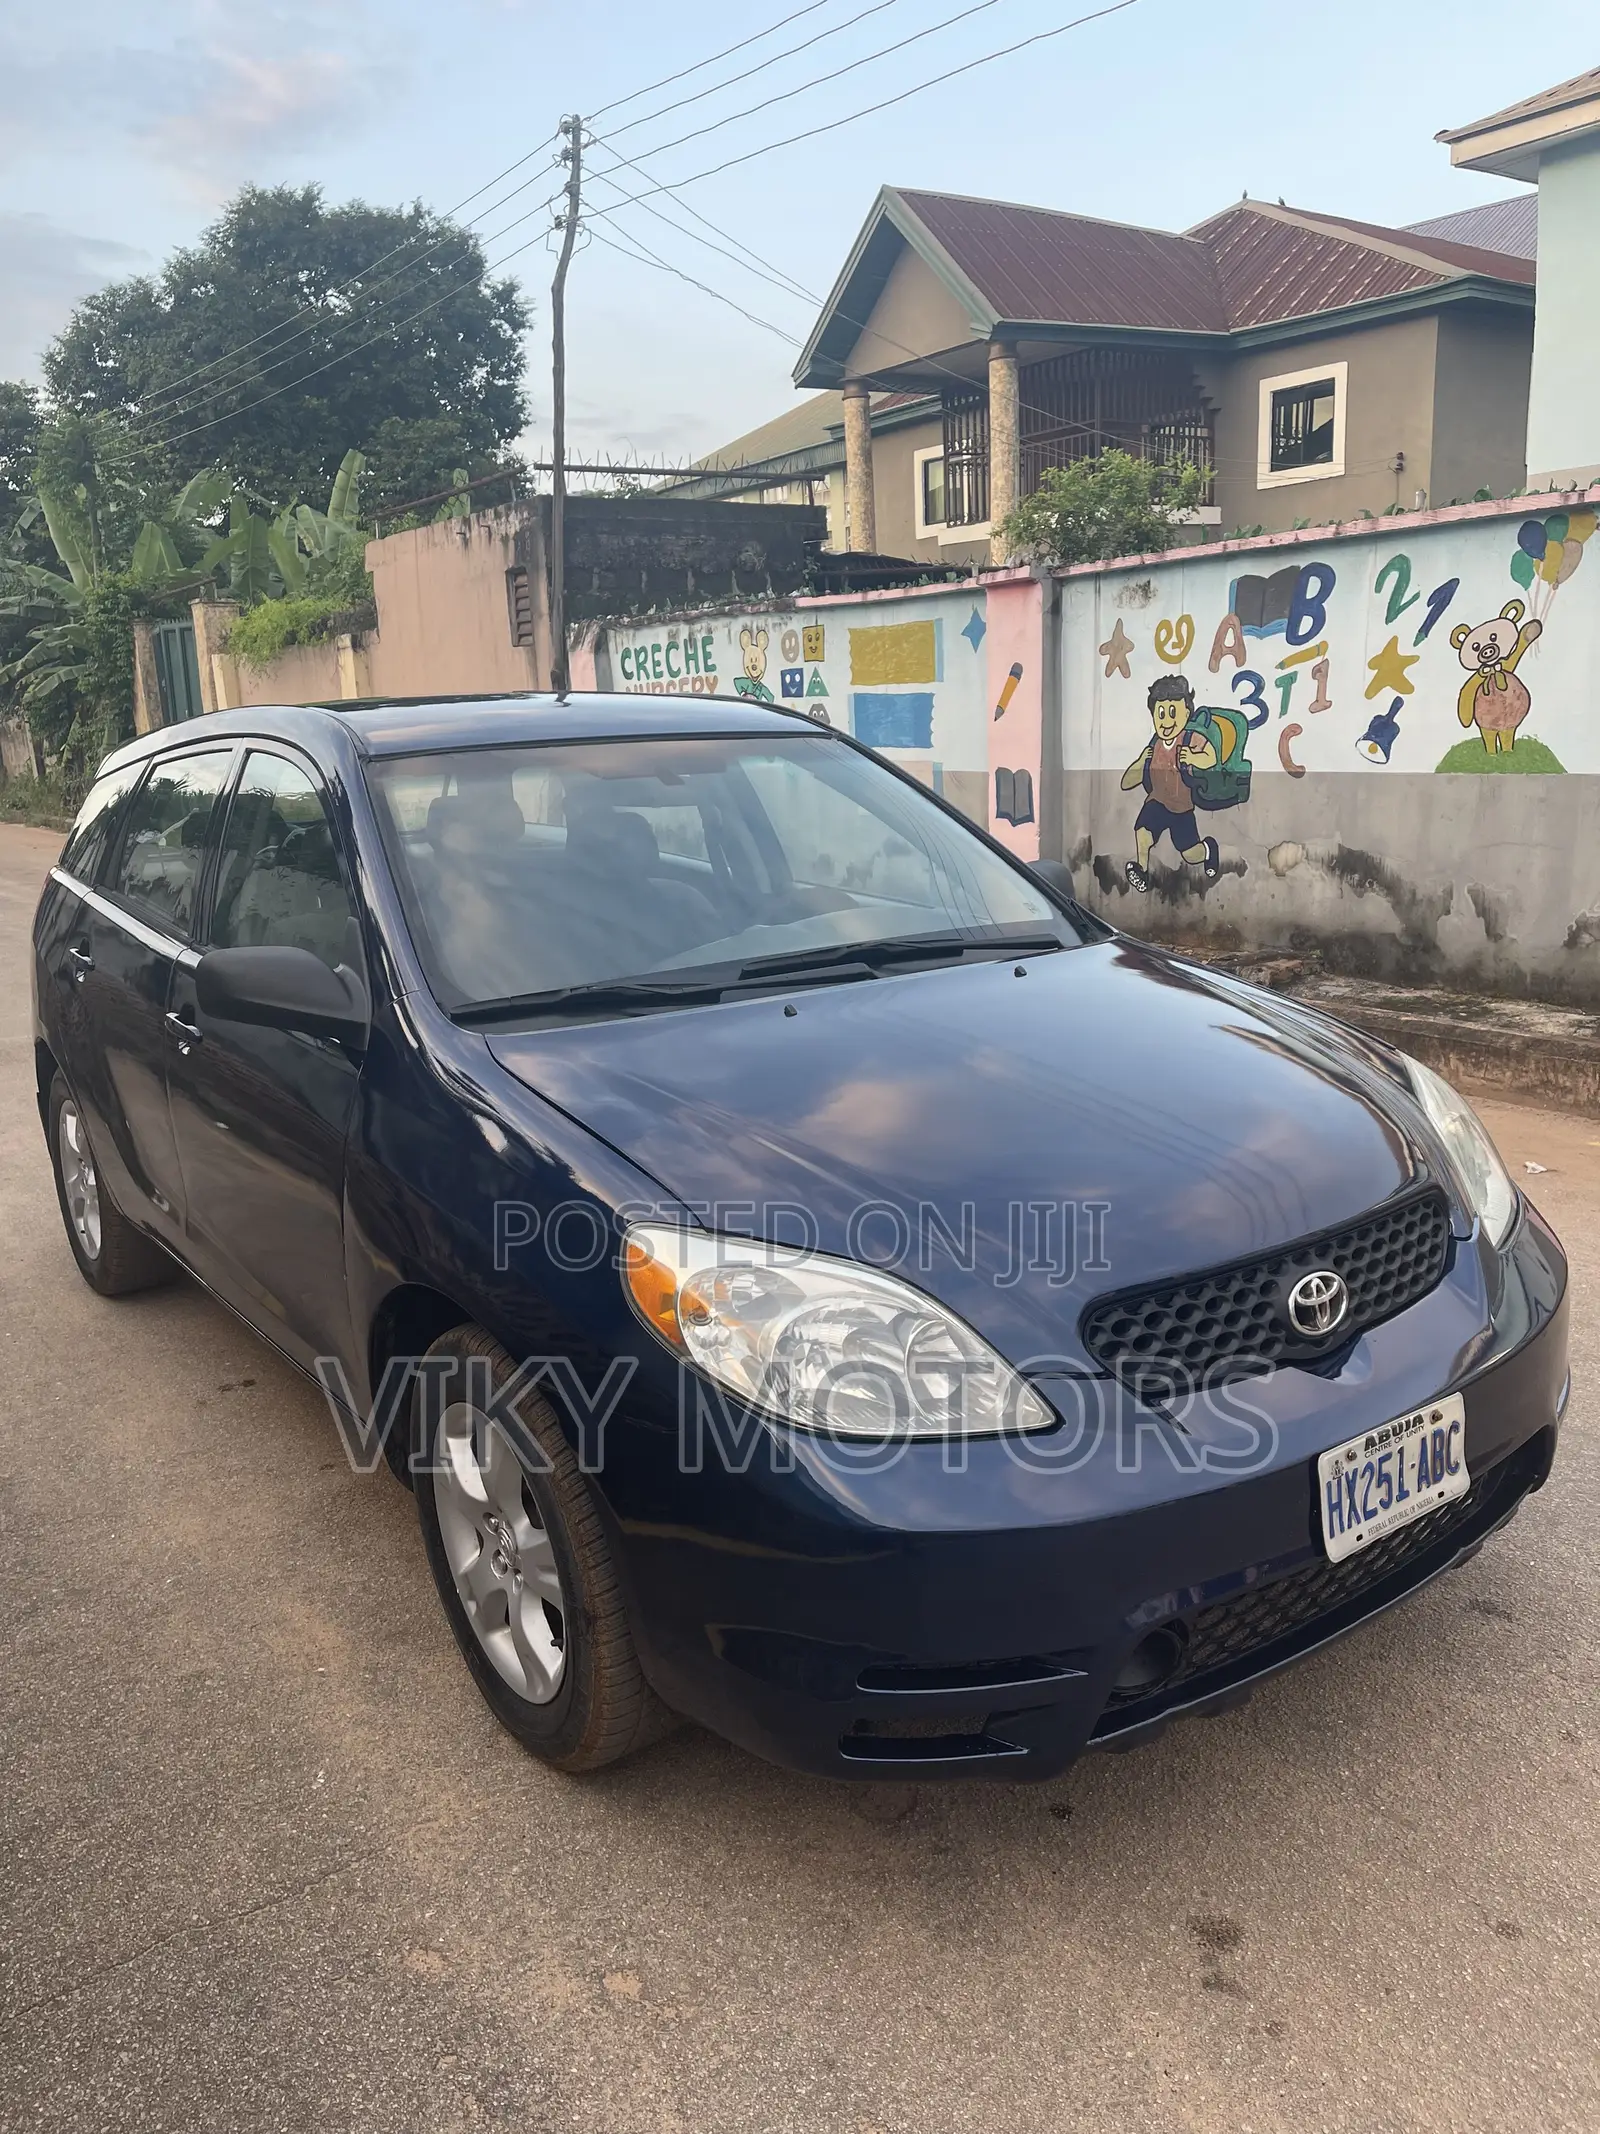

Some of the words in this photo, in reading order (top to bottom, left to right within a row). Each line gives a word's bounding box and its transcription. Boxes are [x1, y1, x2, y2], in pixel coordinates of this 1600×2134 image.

[620, 635, 717, 681] CRECHE
[1363, 1413, 1425, 1452] ABUJA
[1364, 1439, 1393, 1459] CENTRE
[1394, 1433, 1405, 1444] OF
[1406, 1423, 1425, 1438] UNITY
[1367, 1519, 1388, 1537] FEDERAL
